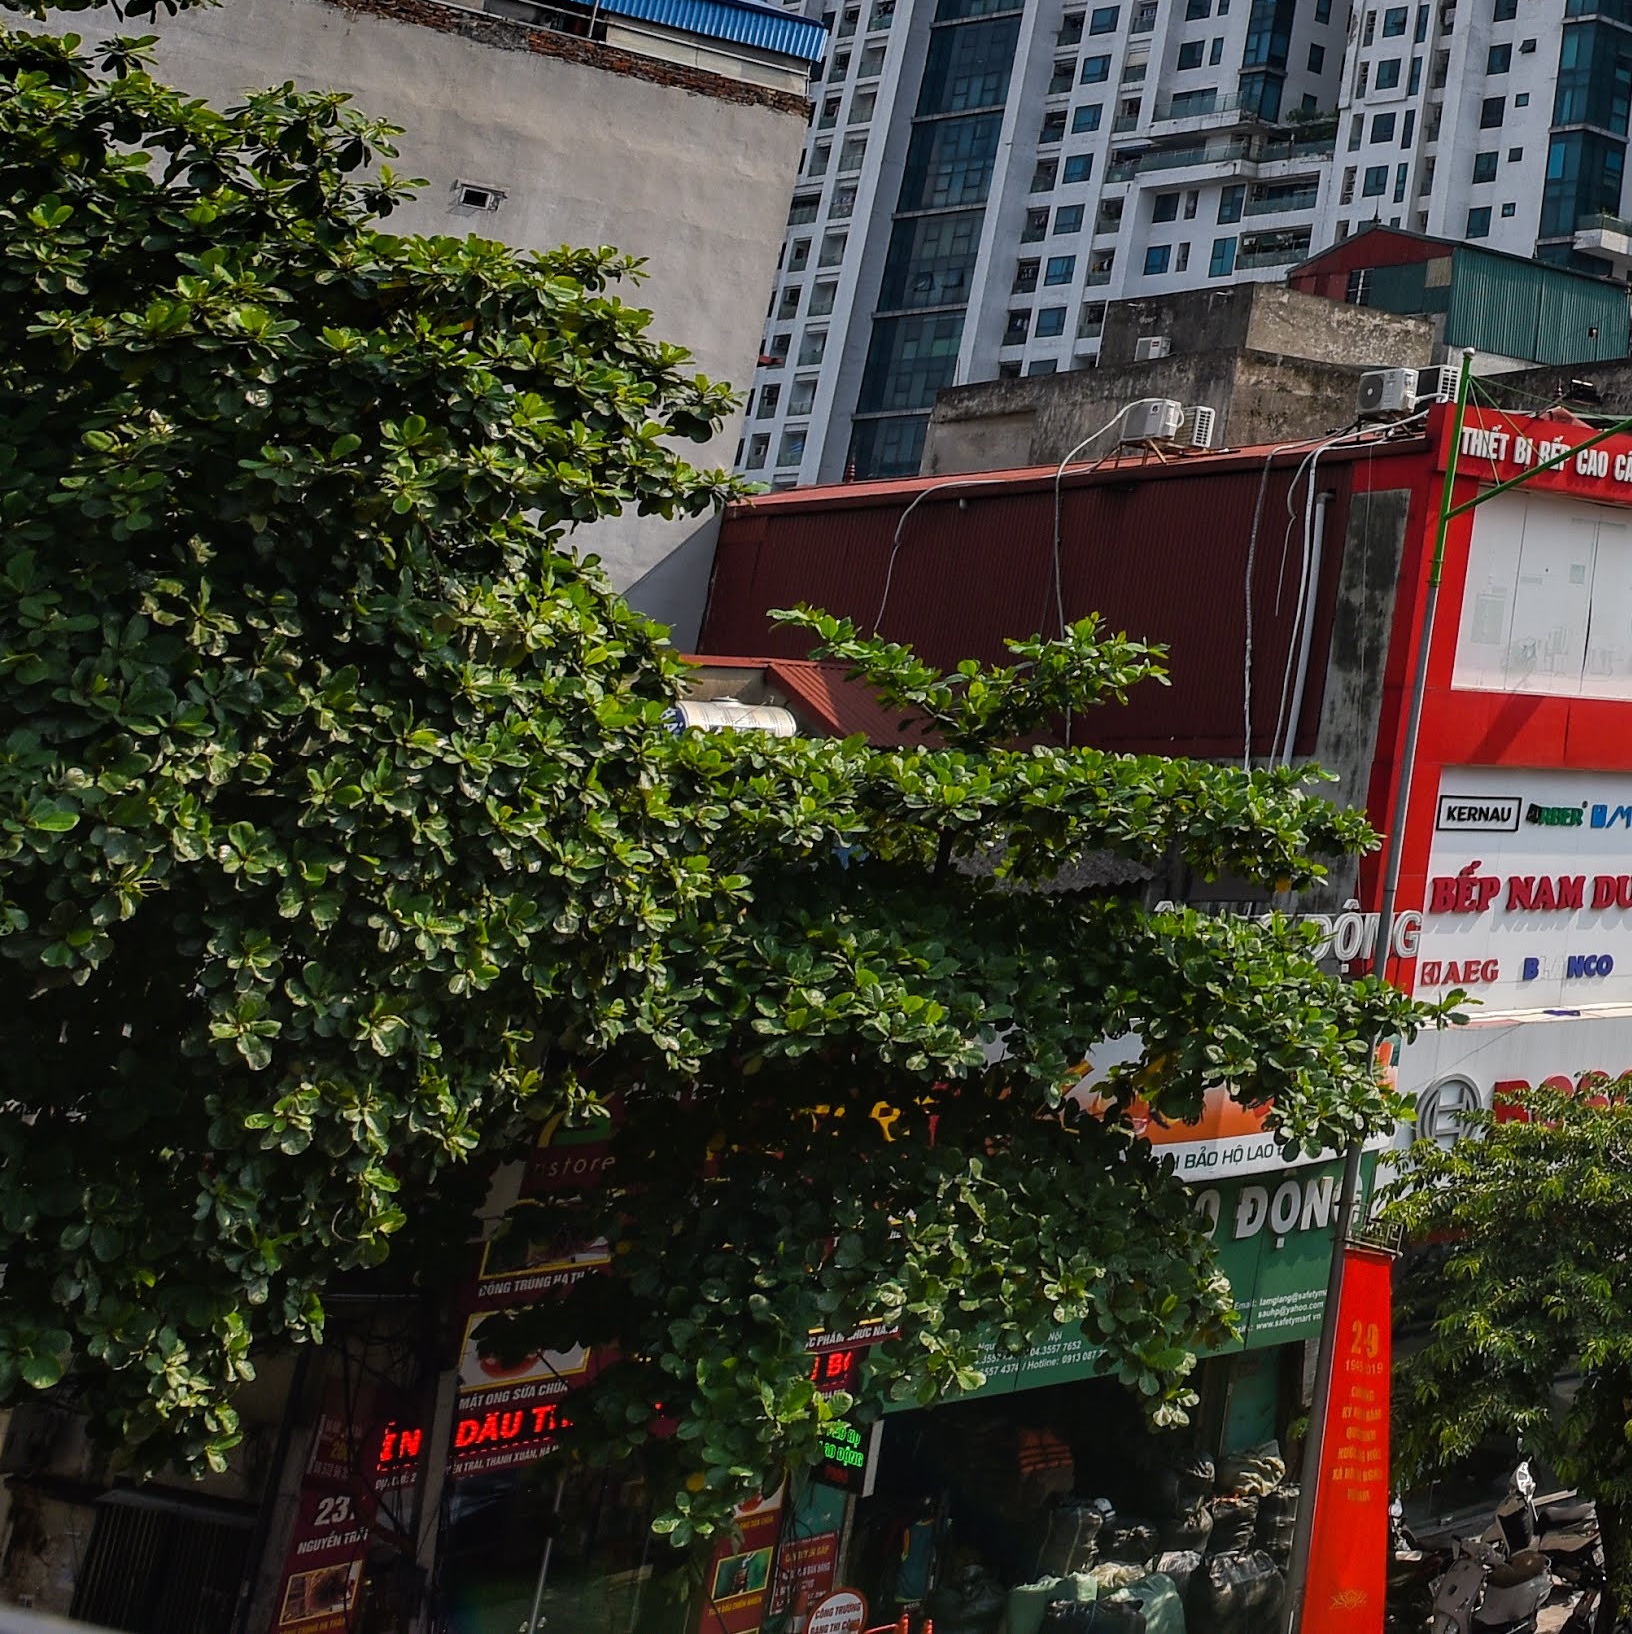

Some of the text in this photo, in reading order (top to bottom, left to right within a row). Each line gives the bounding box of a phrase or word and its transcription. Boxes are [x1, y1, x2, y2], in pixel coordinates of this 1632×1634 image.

[1461, 425, 1510, 461] THIẾT
[1514, 437, 1532, 471] BỊ
[1576, 448, 1609, 478] CAO
[1446, 805, 1513, 823] KERNAU
[1430, 860, 1500, 914] BẾP
[1505, 876, 1585, 911] NAM
[1445, 955, 1613, 985] AEG BNCO
[1184, 1146, 1218, 1170] BẢO
[1222, 1145, 1243, 1169] HỘ
[1247, 1143, 1273, 1161] LAO
[314, 1496, 355, 1526] 23
